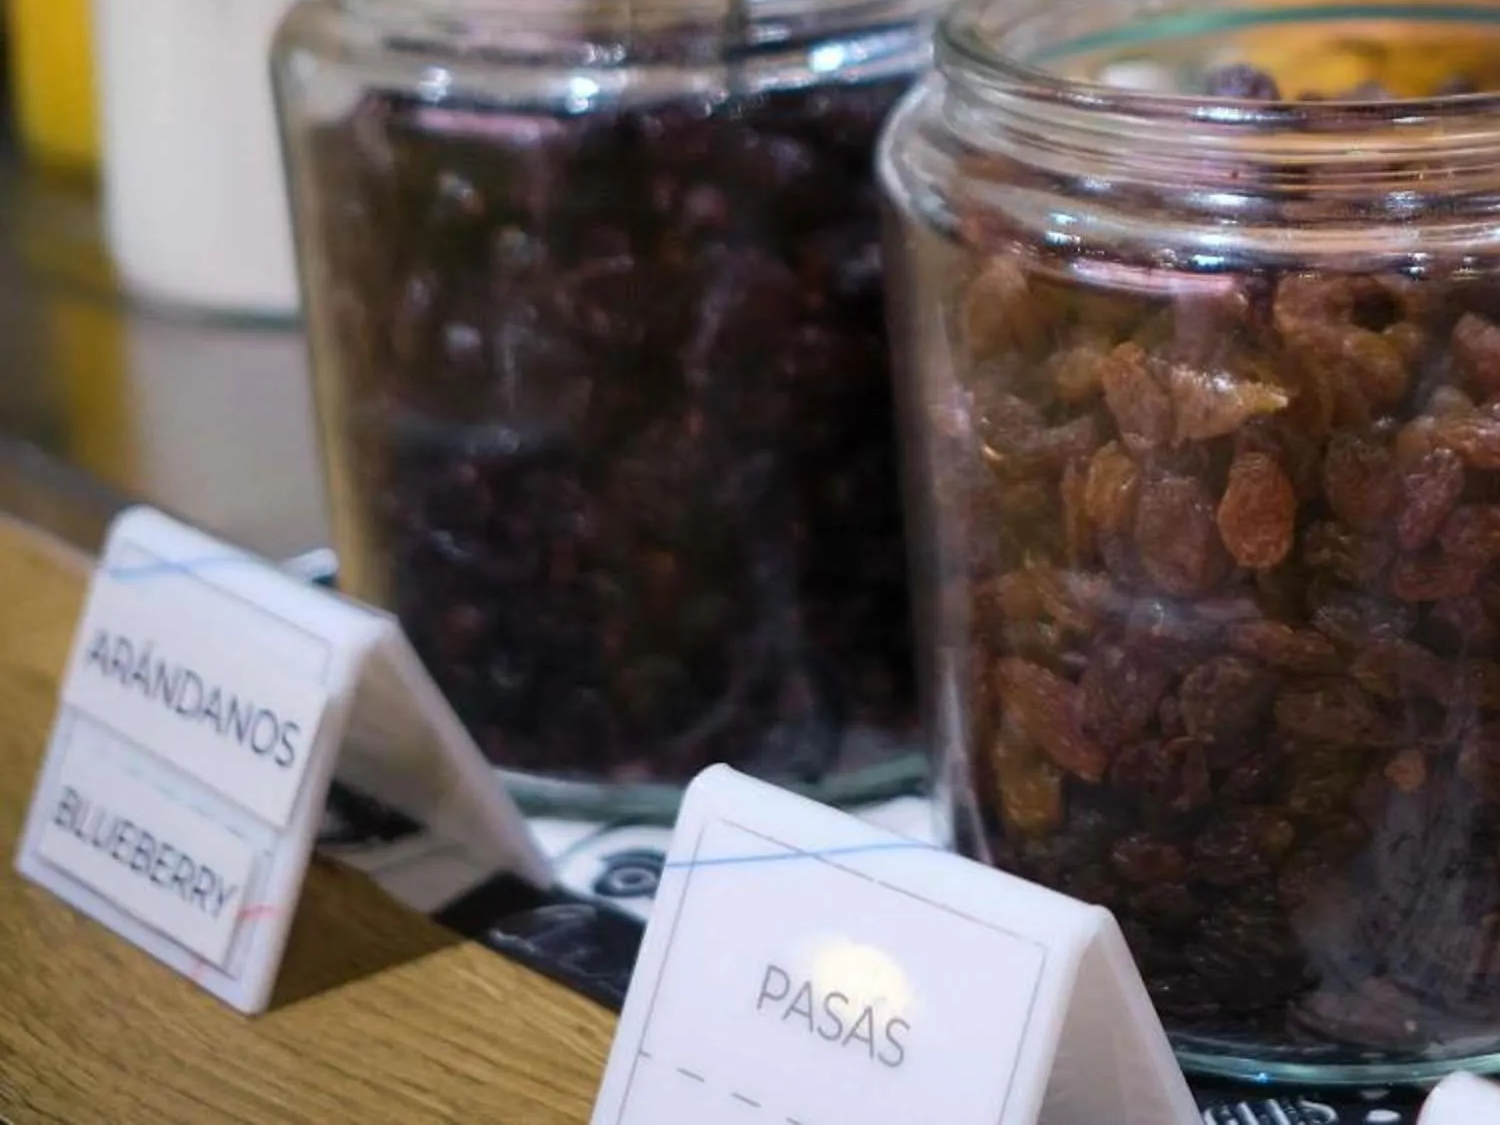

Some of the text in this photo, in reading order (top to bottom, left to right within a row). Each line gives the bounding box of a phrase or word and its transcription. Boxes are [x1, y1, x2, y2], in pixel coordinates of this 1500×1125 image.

[84, 628, 300, 768] ARÁNDANOS
[53, 786, 239, 919] BLUEBERRY
[756, 963, 911, 1068] PASAS
